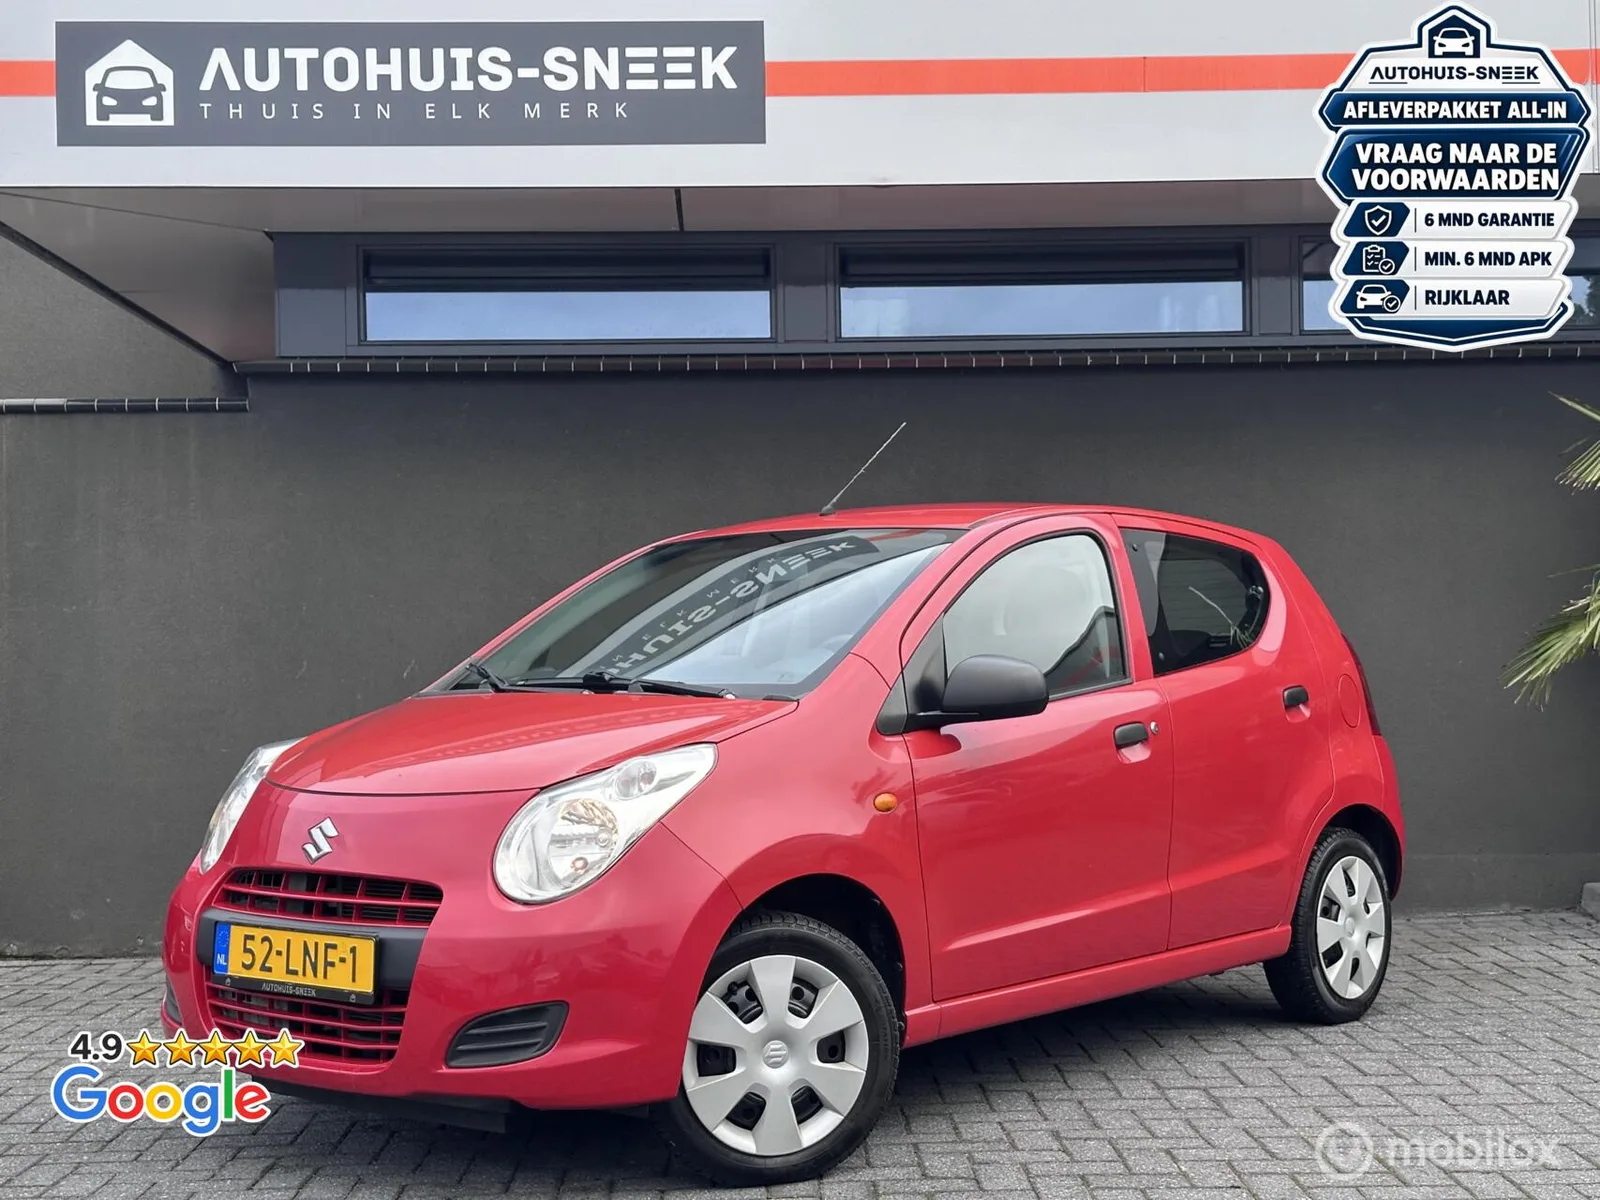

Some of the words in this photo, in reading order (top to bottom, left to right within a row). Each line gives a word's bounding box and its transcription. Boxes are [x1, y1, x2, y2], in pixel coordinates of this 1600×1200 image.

[200, 45, 738, 92] AUTOHUIS-SNEEK
[199, 103, 325, 120] THUIS
[354, 103, 391, 120] IN
[426, 103, 492, 119] ELK
[524, 102, 630, 118] MERK
[216, 953, 228, 966] NL
[241, 933, 358, 983] 52-LNF-1
[261, 982, 316, 997] AUTOHUIS-SNEEK
